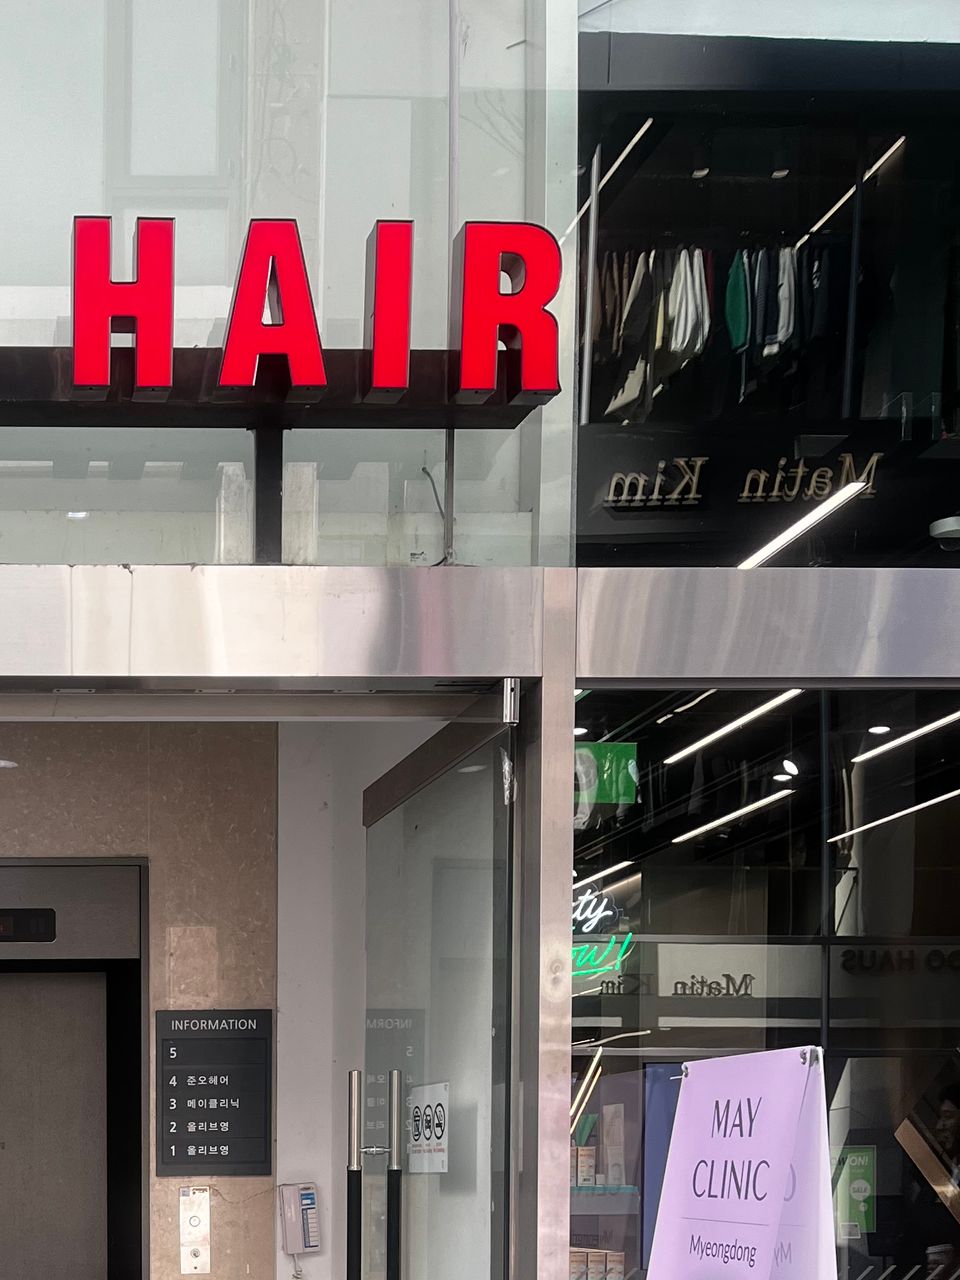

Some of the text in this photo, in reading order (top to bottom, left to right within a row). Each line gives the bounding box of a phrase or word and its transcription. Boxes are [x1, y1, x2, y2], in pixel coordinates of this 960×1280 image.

[72, 215, 563, 393] HAIR
[171, 1019, 257, 1030] INFORMATION
[169, 1047, 177, 1058] 5
[169, 1075, 229, 1087] 4 준오헤어
[169, 1098, 240, 1110] 3 메이클리닉
[711, 1096, 762, 1138] MAY
[169, 1121, 229, 1133] 2 올리브영
[170, 1145, 229, 1157] 1 올리브영
[692, 1159, 770, 1202] CLINIC
[689, 1234, 757, 1268] Myeongdong
